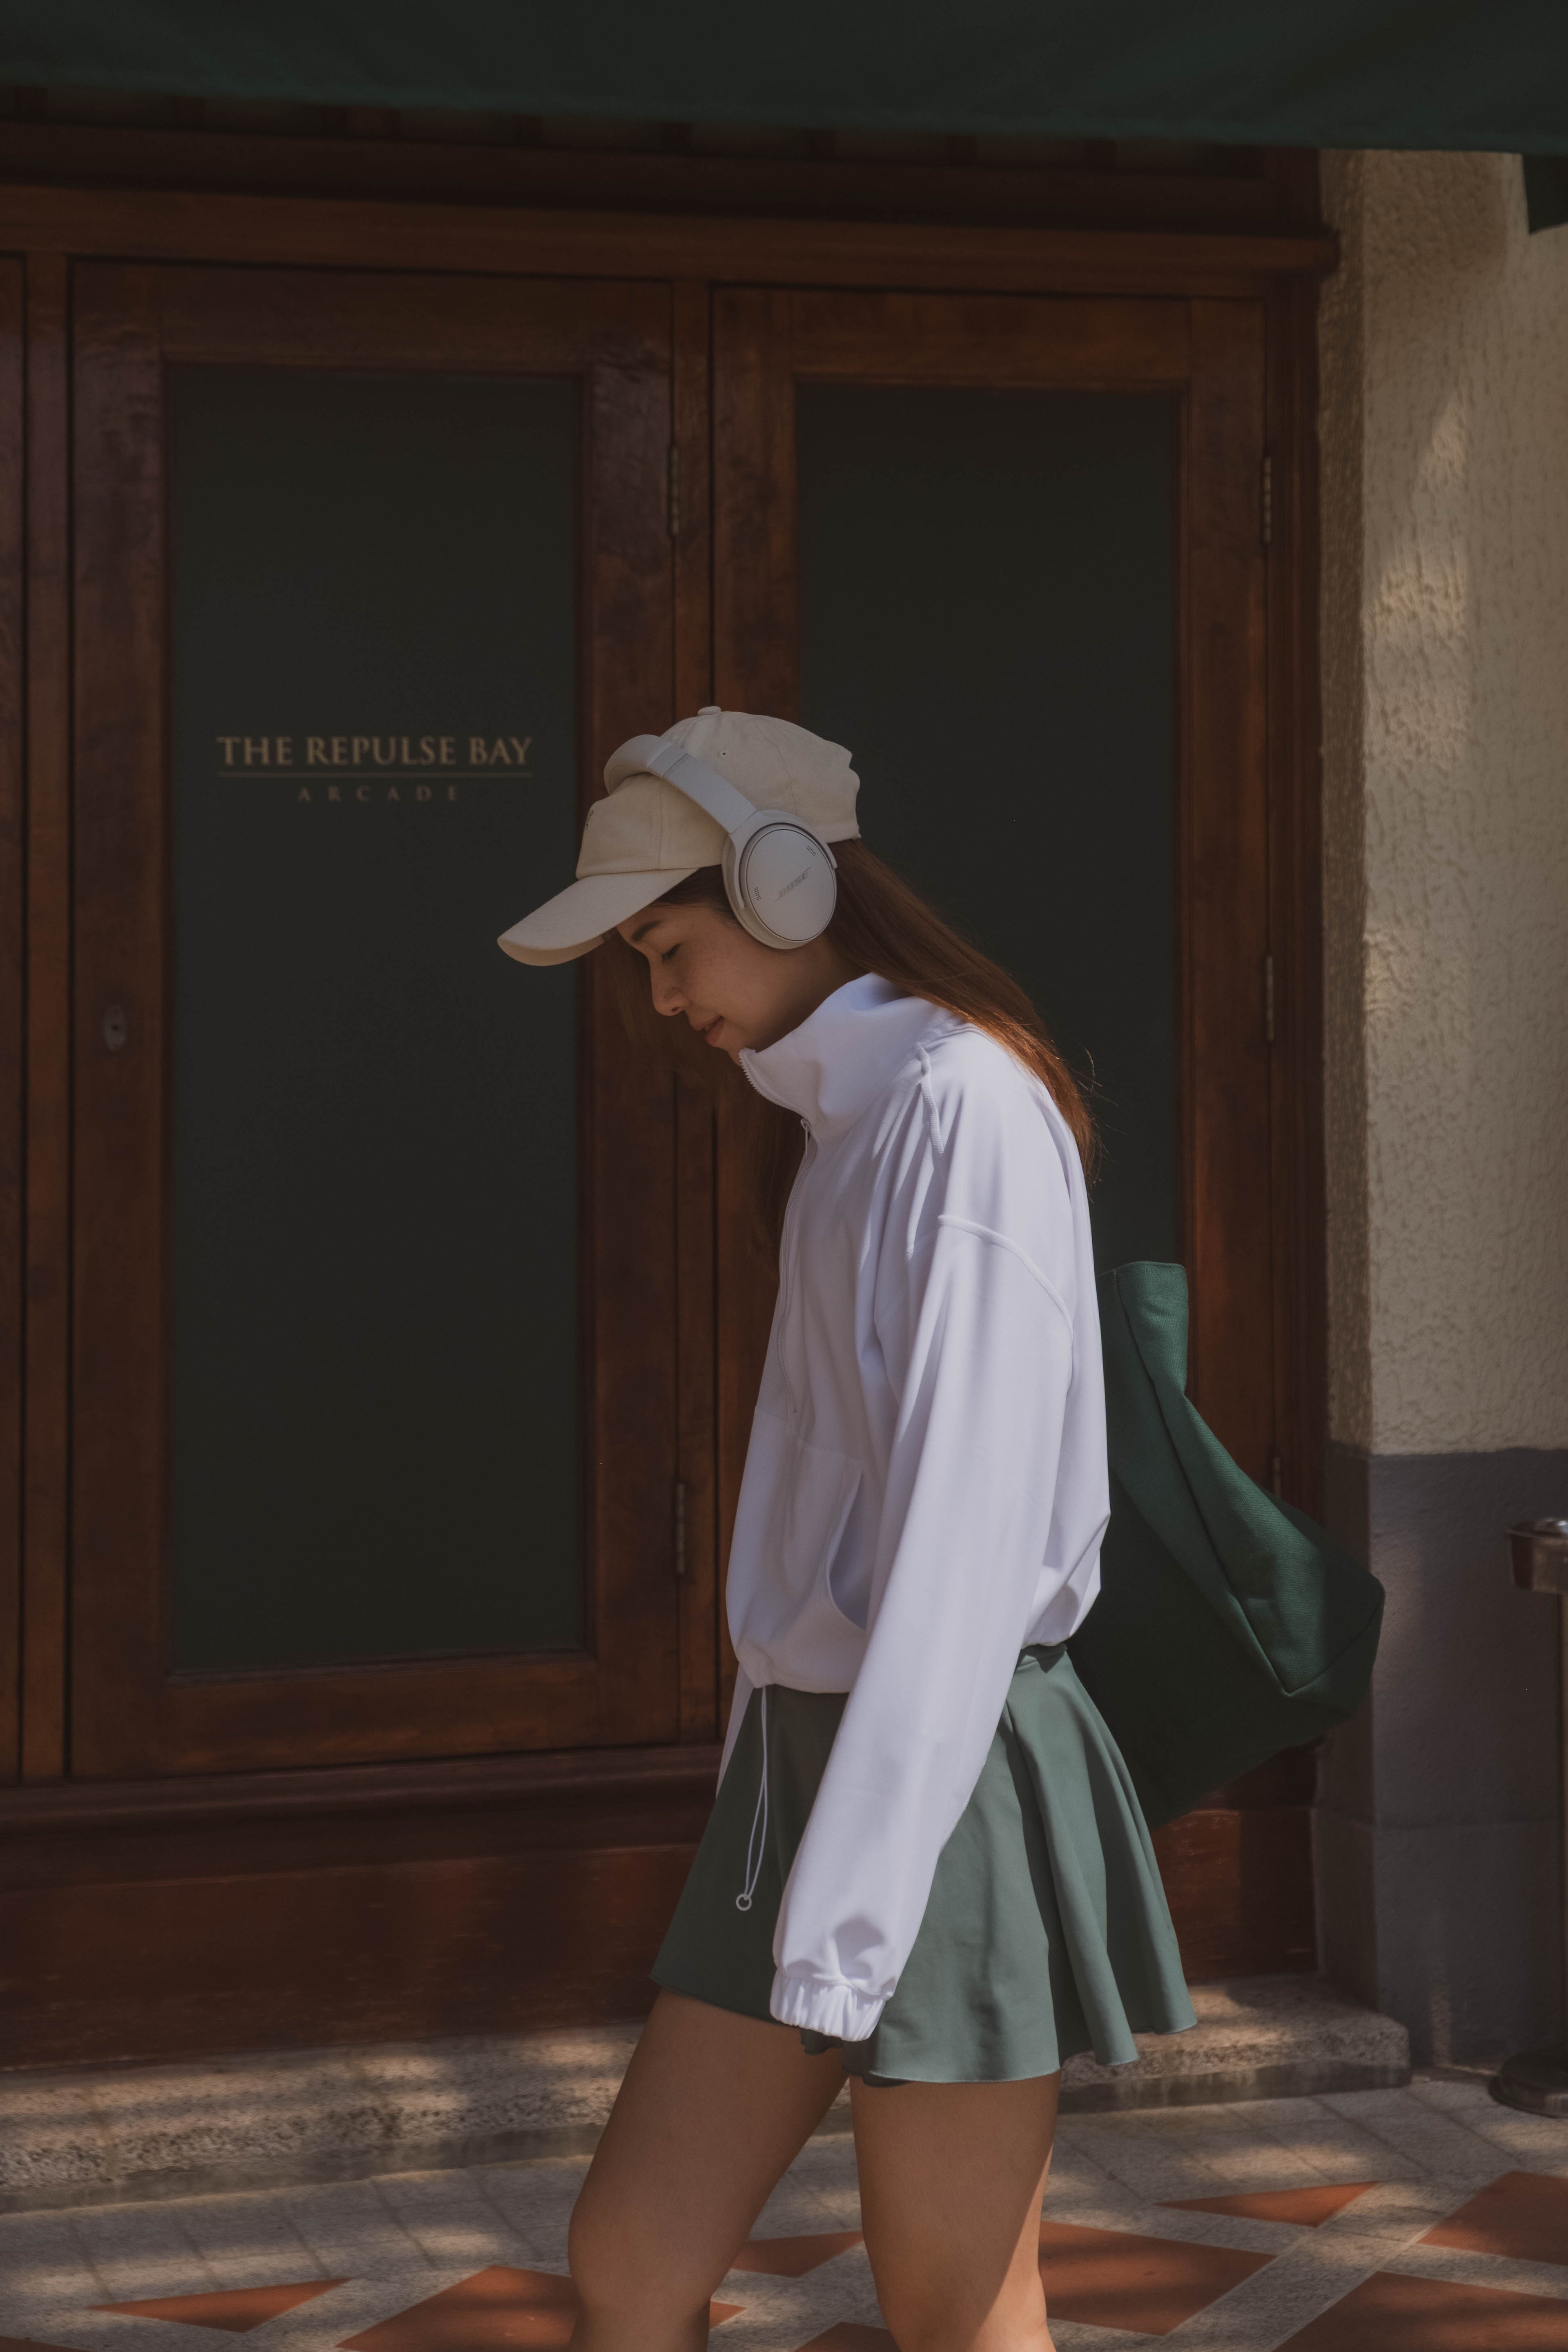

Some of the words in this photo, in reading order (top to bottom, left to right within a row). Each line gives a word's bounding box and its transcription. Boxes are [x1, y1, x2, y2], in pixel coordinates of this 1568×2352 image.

[217, 736, 292, 765] THE
[306, 736, 457, 765] REPULSE
[469, 736, 532, 765] BAY
[297, 785, 458, 802] ARCADE
[775, 866, 811, 902] BOSE
